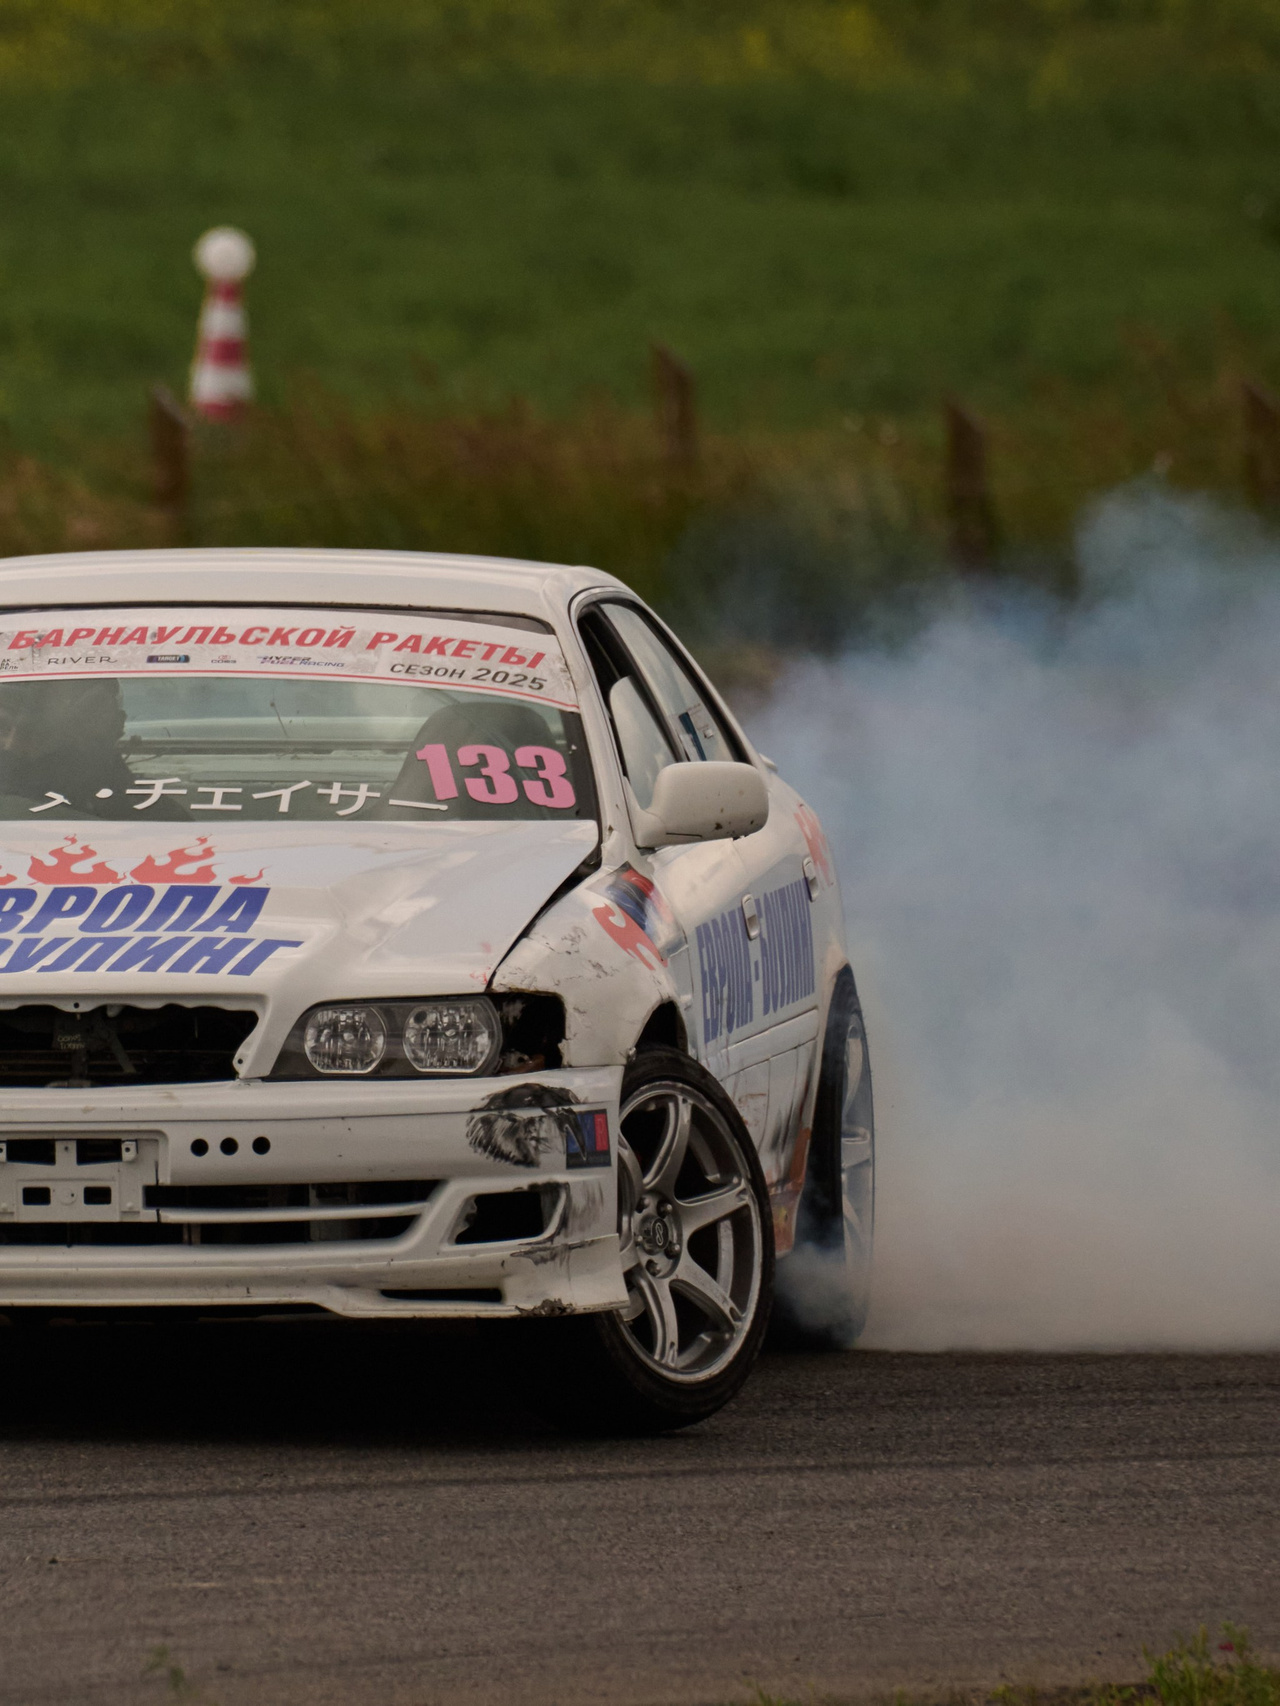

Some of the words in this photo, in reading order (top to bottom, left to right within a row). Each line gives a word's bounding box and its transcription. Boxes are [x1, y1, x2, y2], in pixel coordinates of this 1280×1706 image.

[7, 625, 356, 650] БАРНАУЛЬСКОЙ
[365, 632, 546, 669] РАКЕТЫ
[47, 656, 118, 665] RIVER
[390, 663, 466, 679] СЕЗОН
[471, 668, 548, 691] 2025
[417, 743, 576, 809] 133
